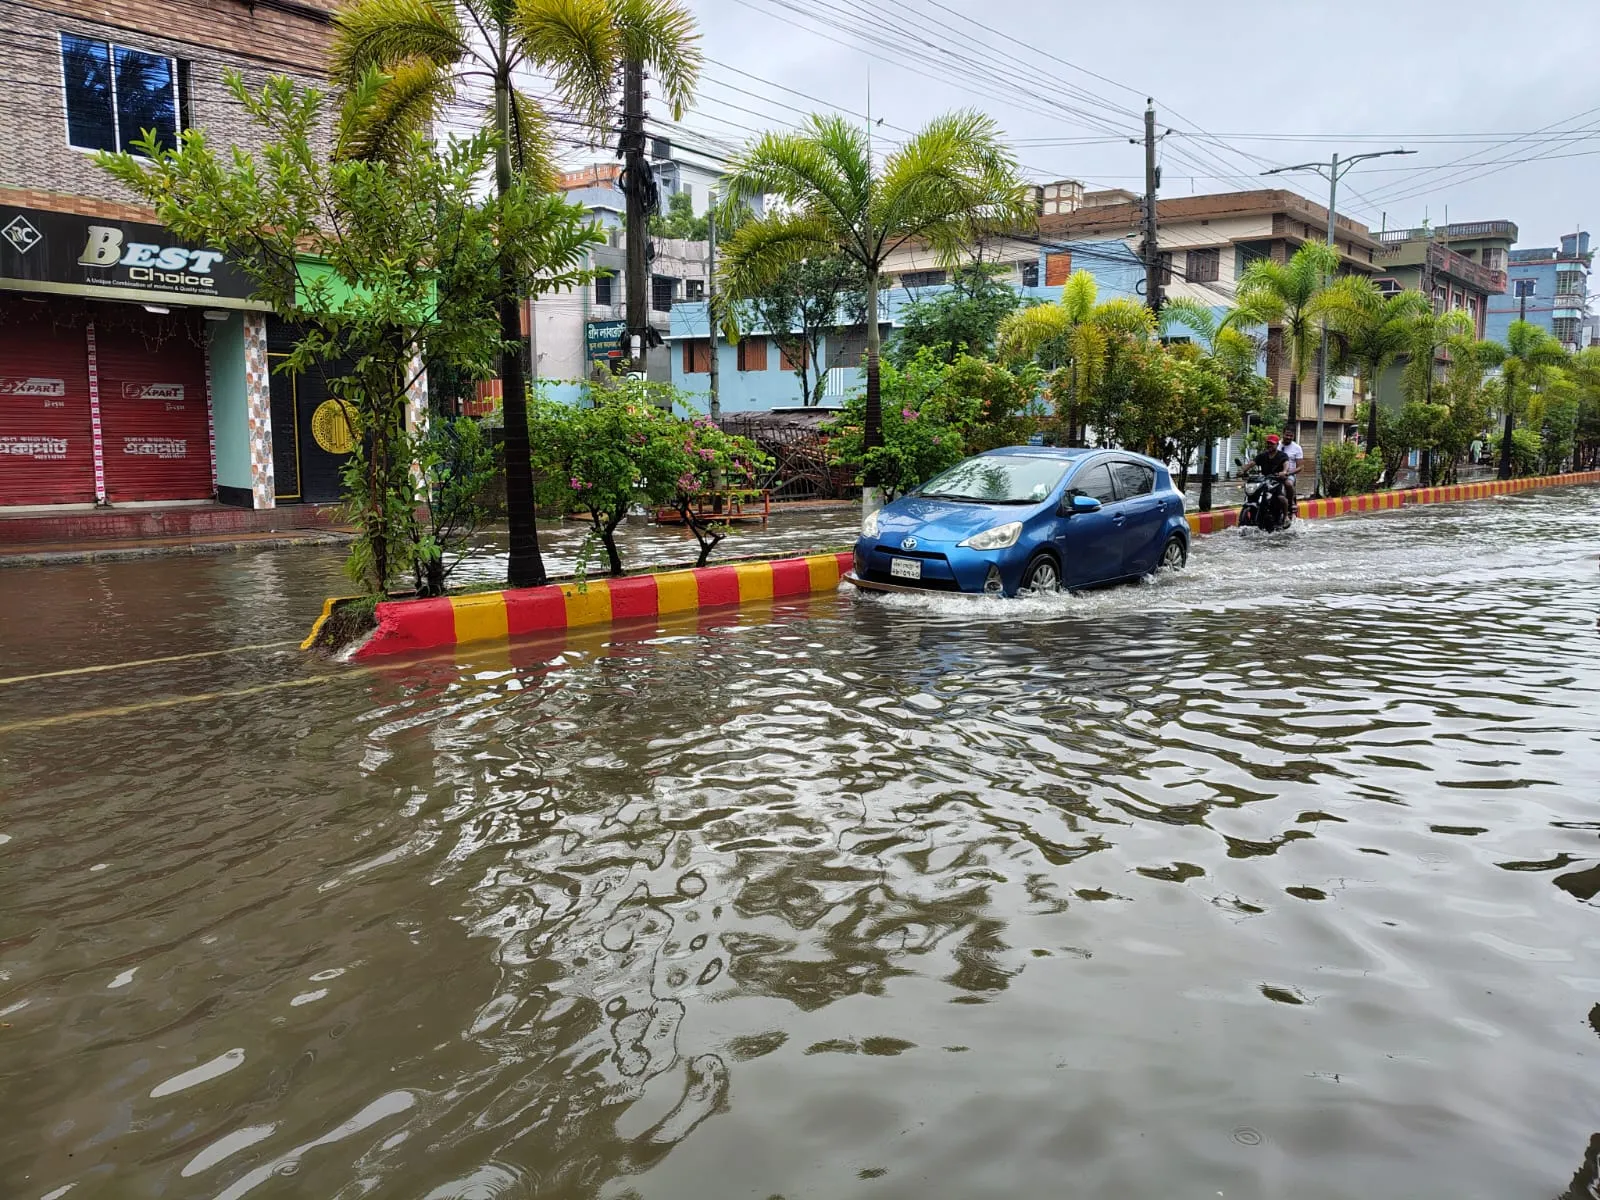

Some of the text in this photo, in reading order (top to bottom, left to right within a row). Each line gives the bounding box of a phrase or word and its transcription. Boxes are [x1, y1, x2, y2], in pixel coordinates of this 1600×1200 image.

[91, 277, 111, 286] Unique
[112, 279, 147, 288] Combination
[129, 267, 215, 287] Choice
